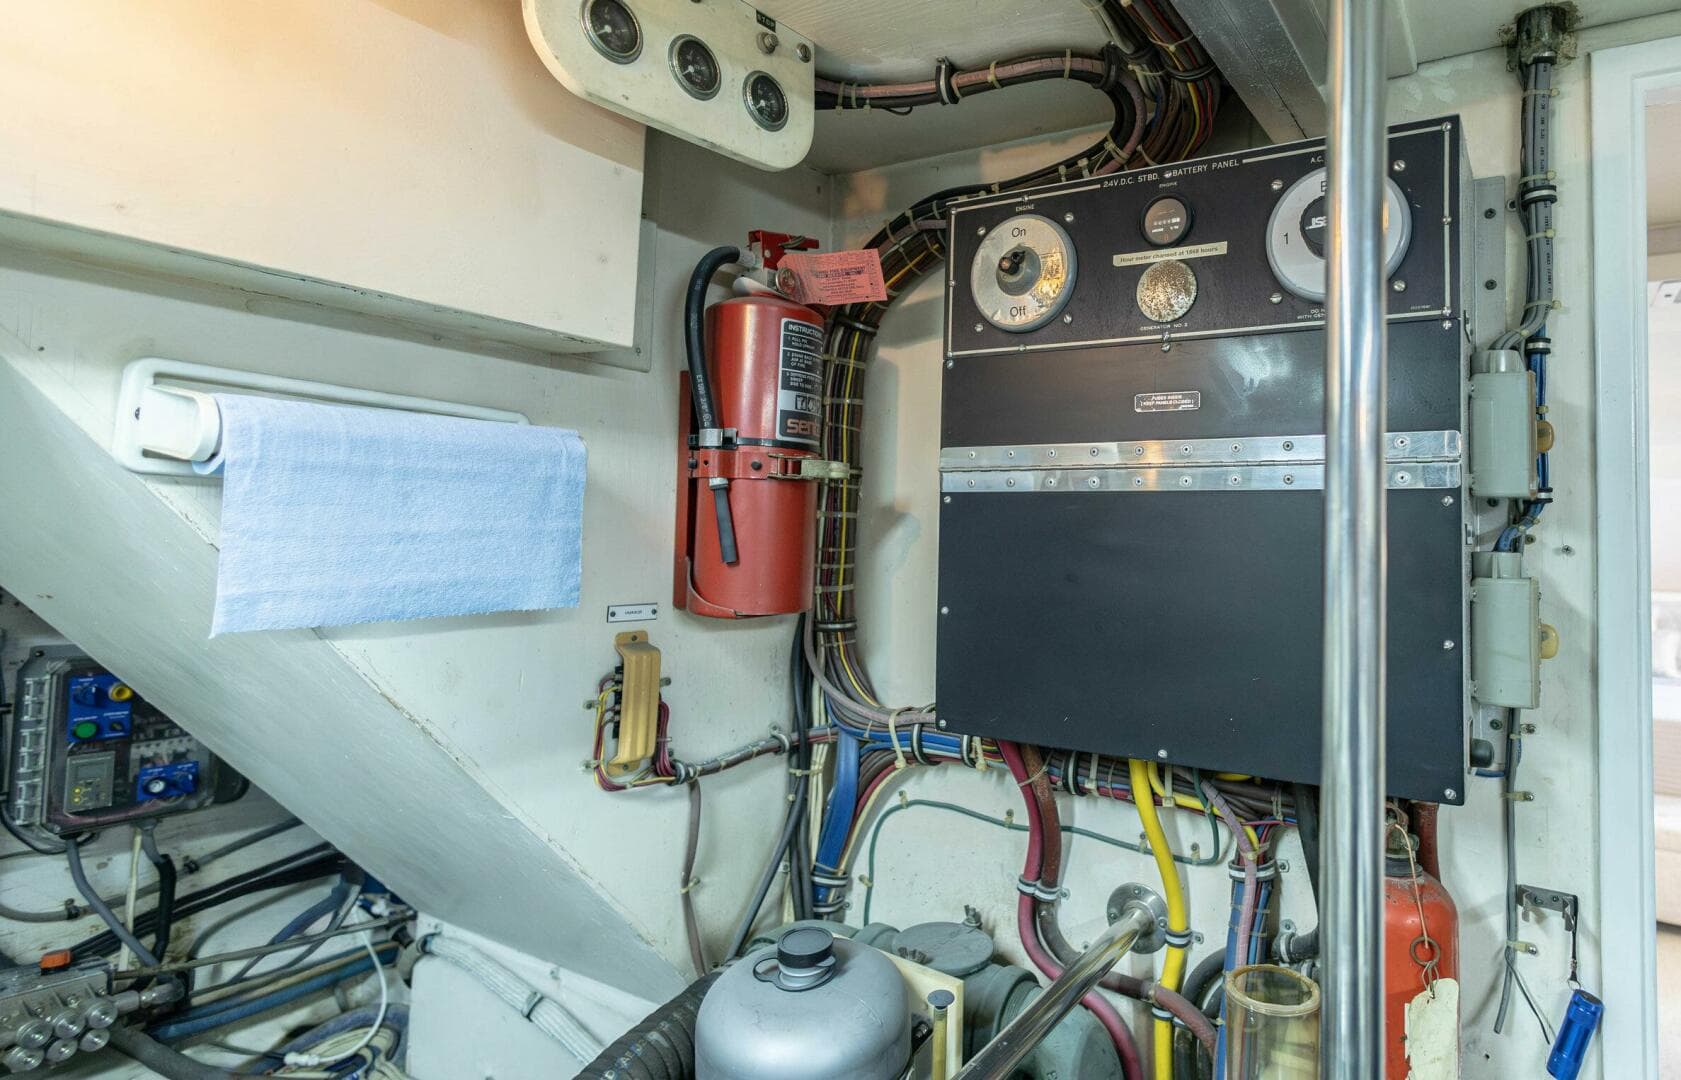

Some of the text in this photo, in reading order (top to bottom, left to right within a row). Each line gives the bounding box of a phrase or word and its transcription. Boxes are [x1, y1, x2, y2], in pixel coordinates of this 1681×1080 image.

[1172, 164, 1208, 177] BATTERY
[1211, 160, 1240, 170] PANEL
[1016, 204, 1035, 212] ENGINE
[1012, 227, 1026, 238] On
[1283, 233, 1289, 245] 1
[1200, 246, 1218, 254] hours
[1010, 306, 1026, 317] Off
